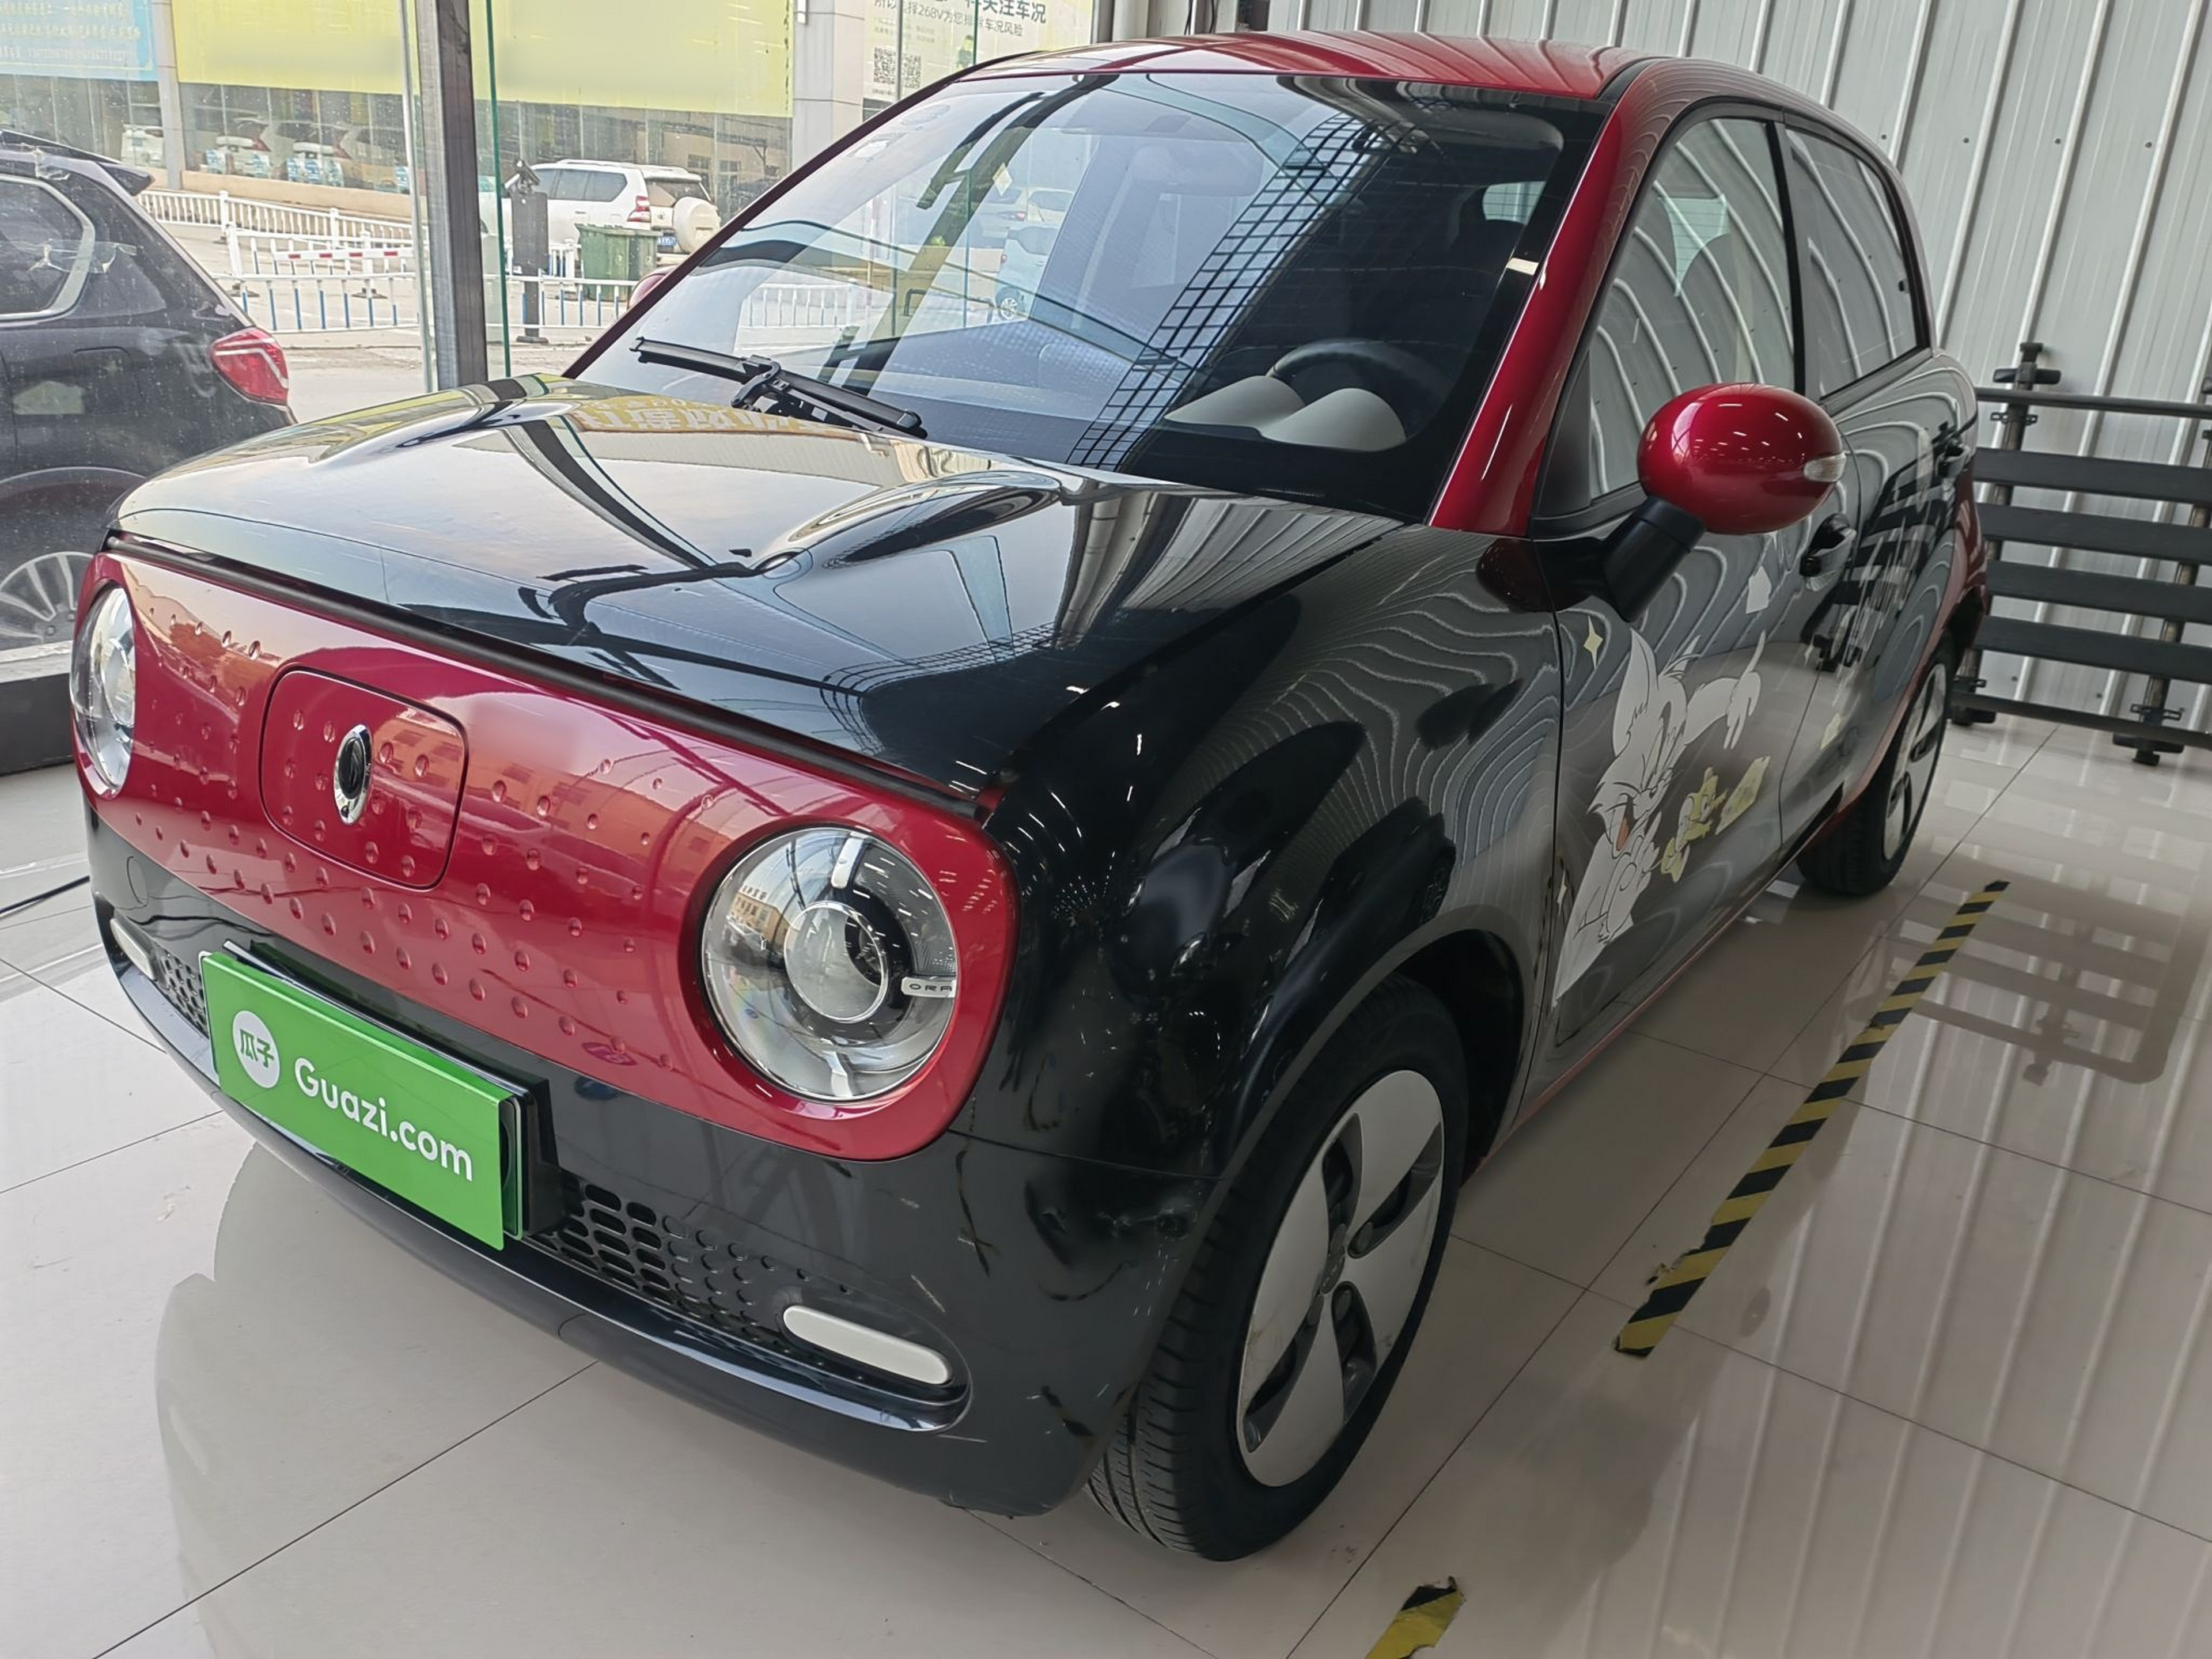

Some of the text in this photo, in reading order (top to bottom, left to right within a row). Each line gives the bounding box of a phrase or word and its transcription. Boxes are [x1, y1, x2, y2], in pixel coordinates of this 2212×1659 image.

[909, 983, 953, 992] ORA
[239, 1028, 275, 1069] 瓜子
[294, 1057, 472, 1182] Guazi.com
